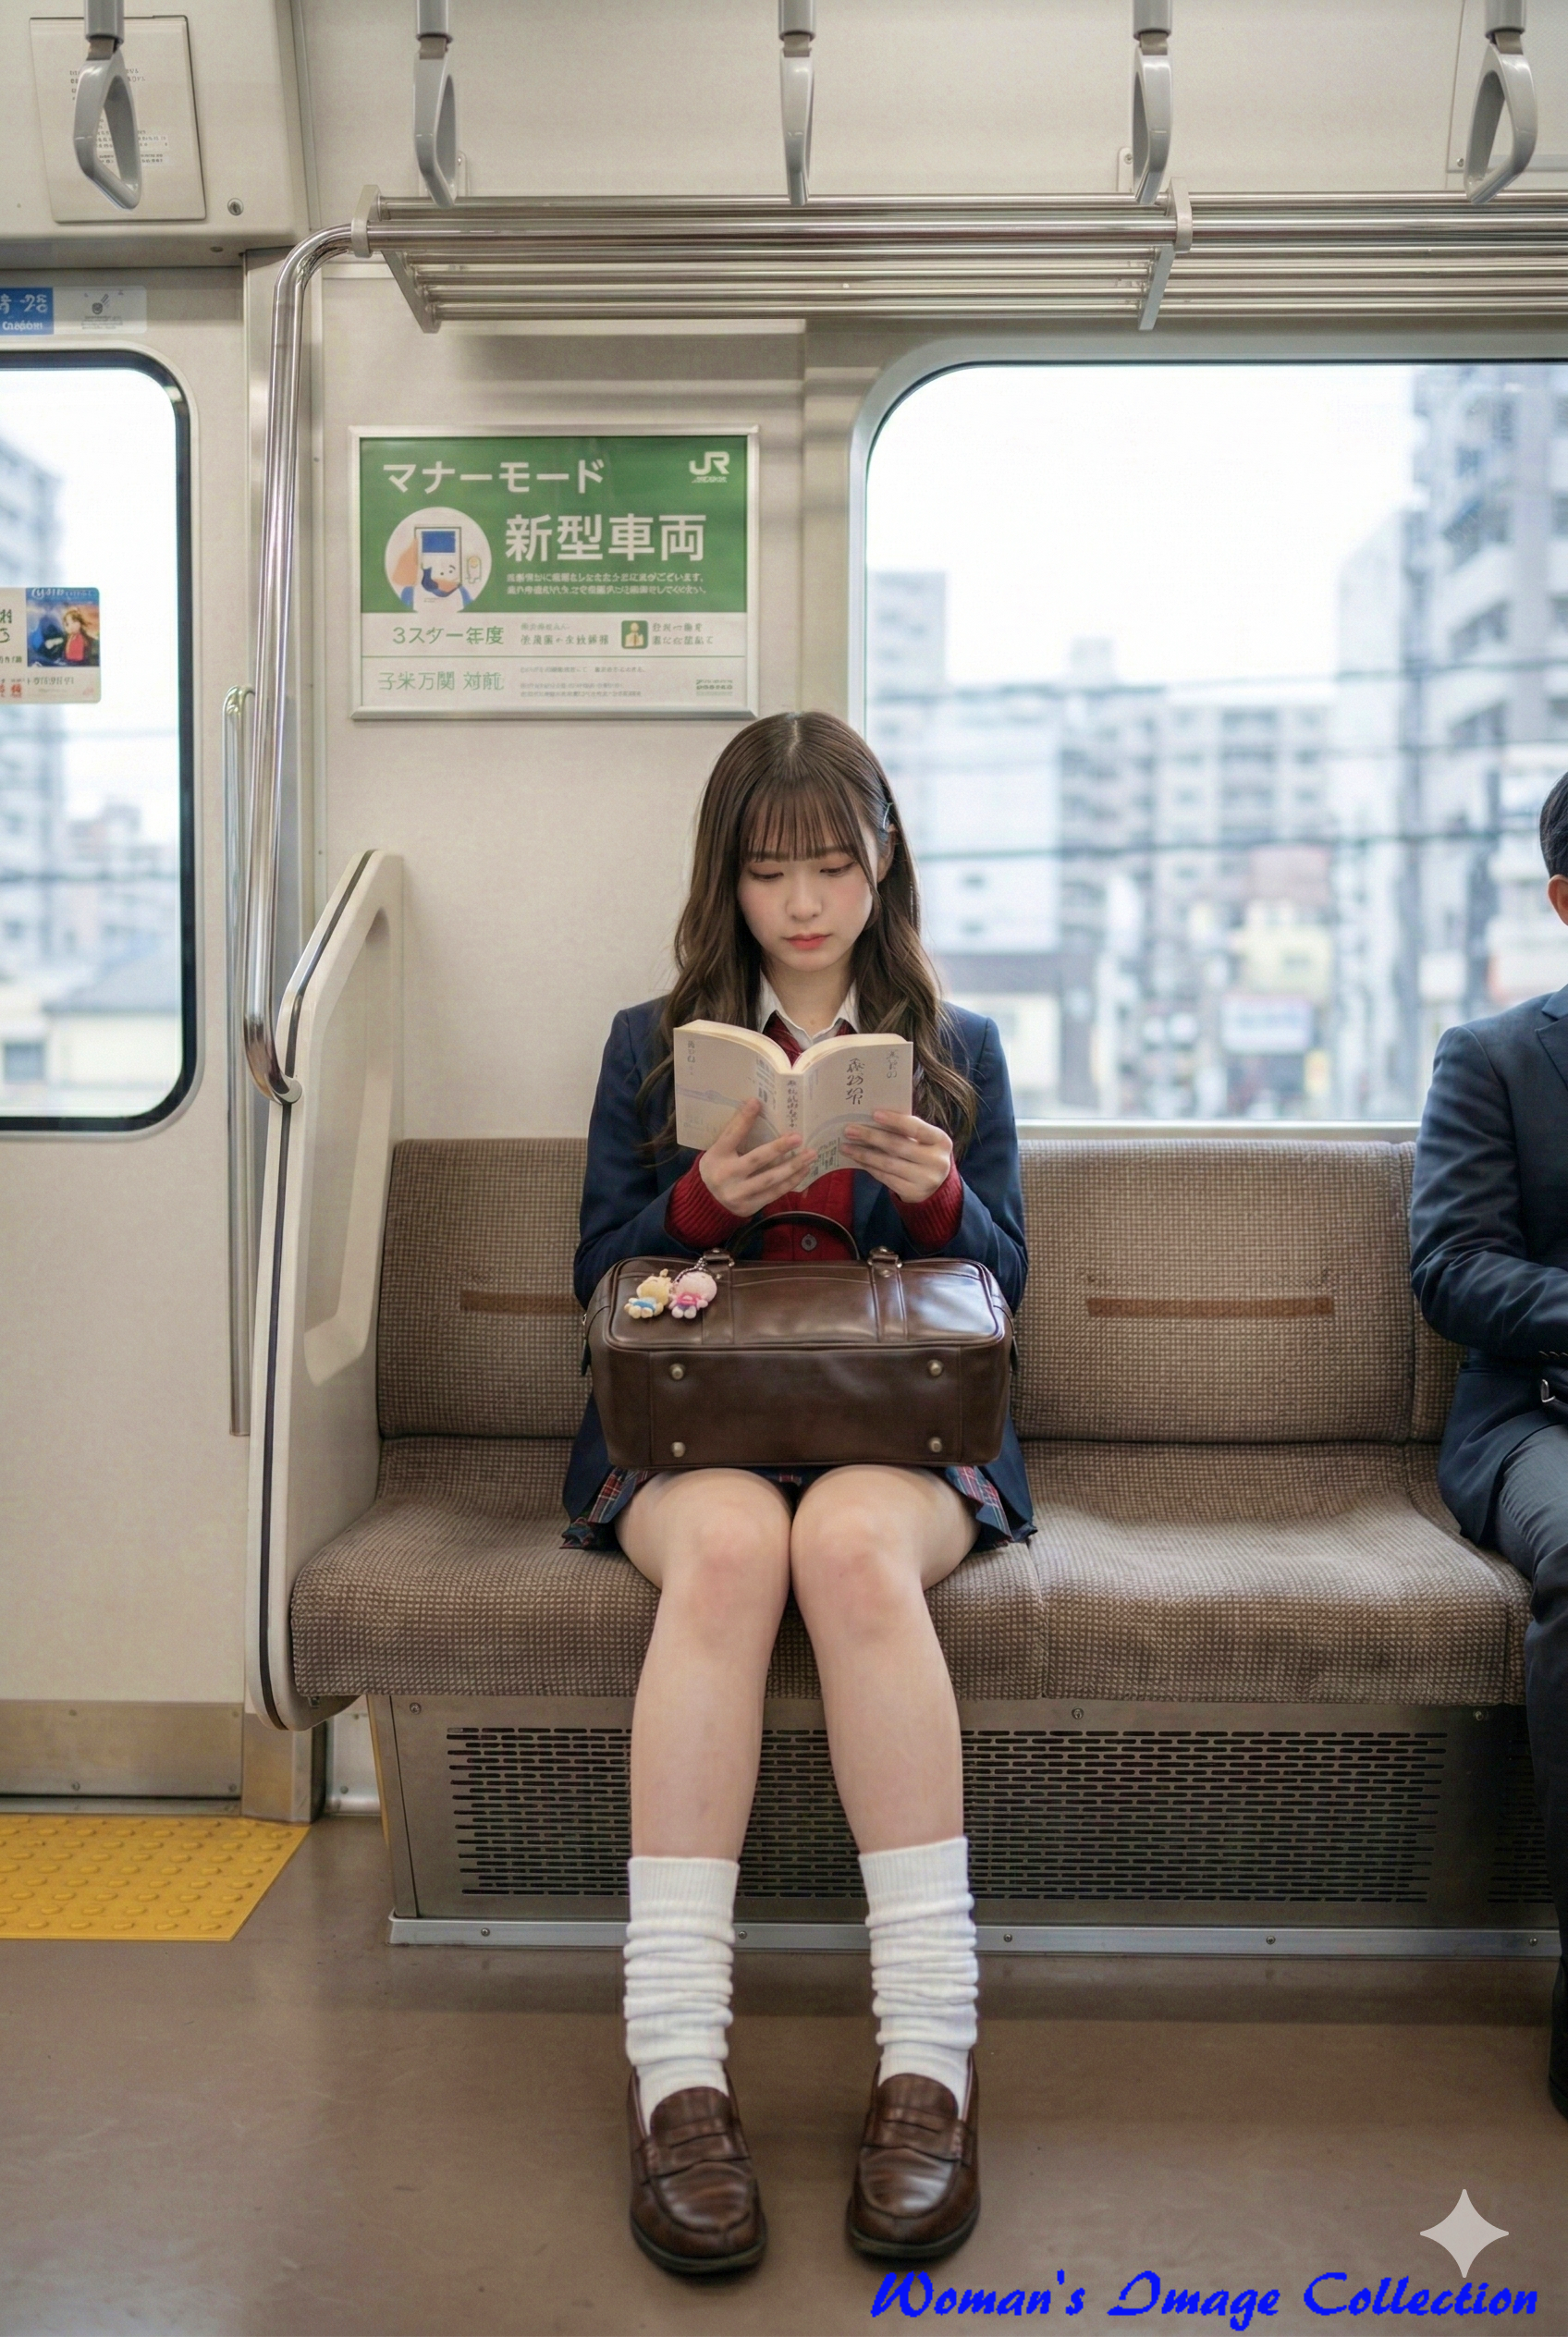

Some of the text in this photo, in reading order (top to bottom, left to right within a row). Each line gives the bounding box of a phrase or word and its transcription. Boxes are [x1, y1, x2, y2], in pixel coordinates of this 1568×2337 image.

[383, 459, 605, 495] マナーモード
[689, 451, 730, 475] JR
[506, 513, 707, 562] 新型車両
